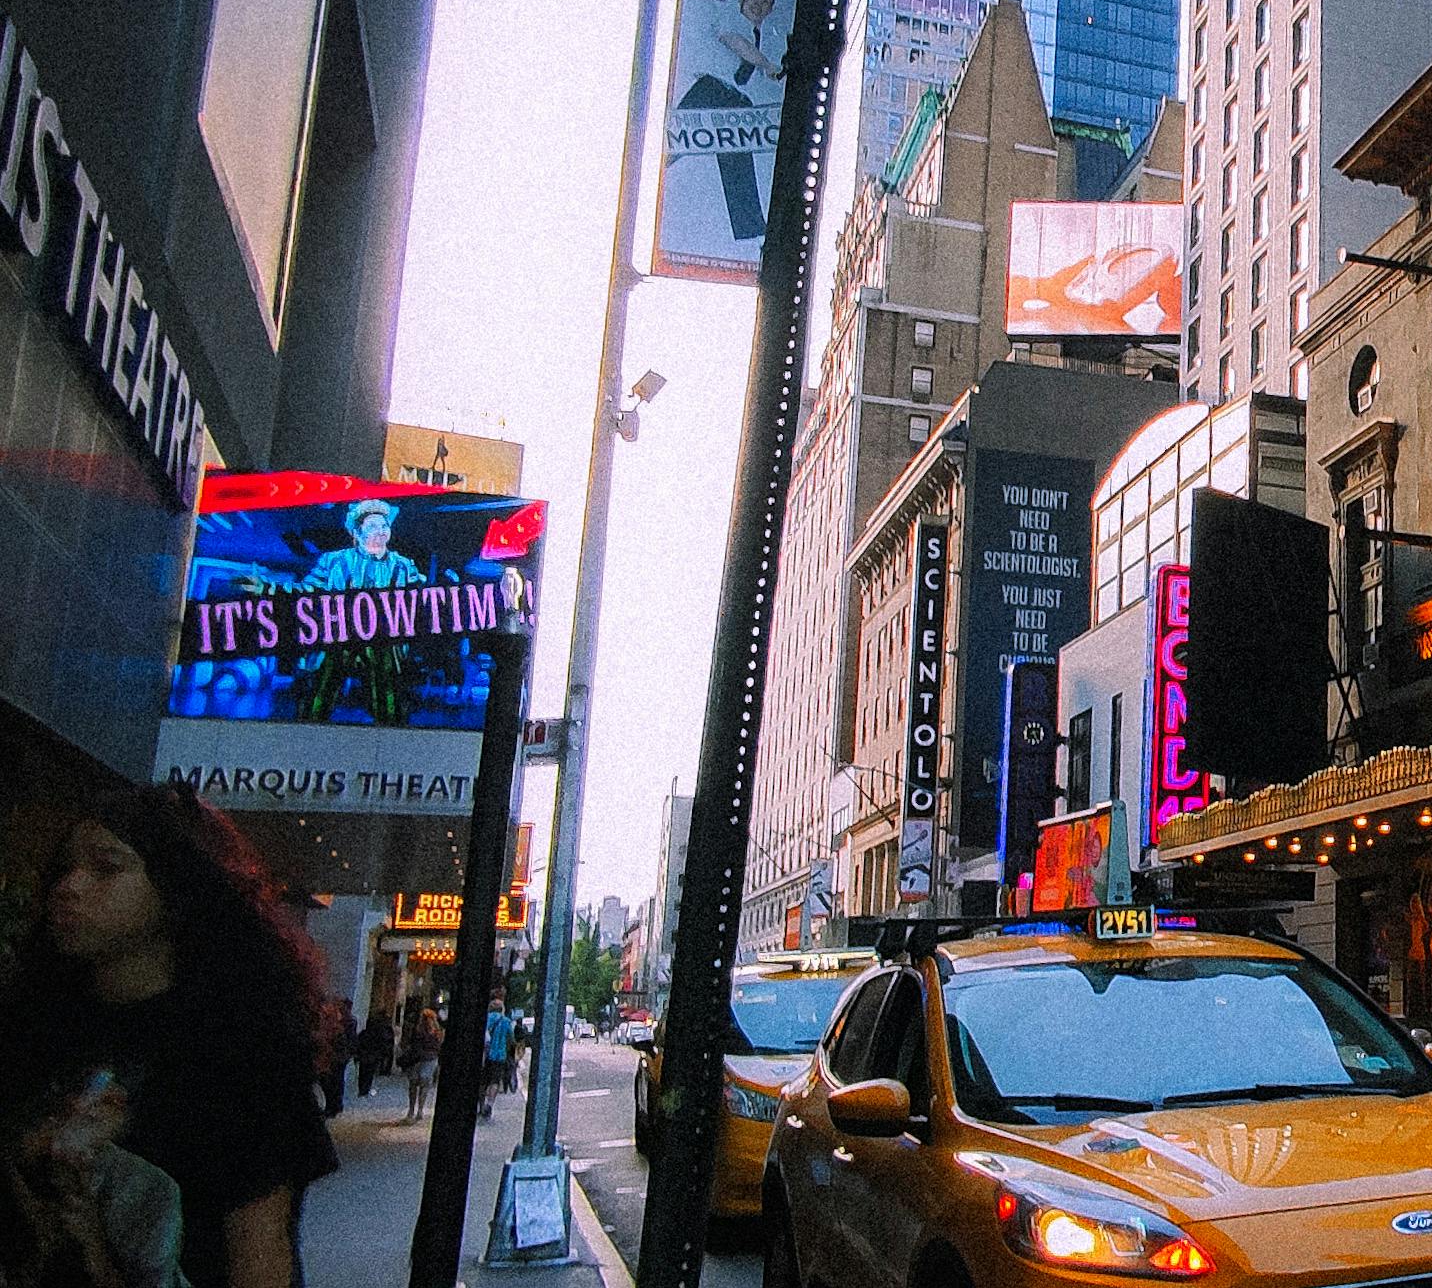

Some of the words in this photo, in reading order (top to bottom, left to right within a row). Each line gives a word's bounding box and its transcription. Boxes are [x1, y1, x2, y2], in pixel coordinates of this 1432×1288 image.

[66, 160, 206, 513] THEATRE
[1002, 484, 1029, 506] YOU
[1031, 488, 1070, 511] DON'T
[1019, 509, 1050, 530] NEED
[1010, 530, 1027, 550] TO
[1030, 533, 1046, 553] BE
[1049, 535, 1058, 553] A
[983, 551, 1081, 579] SCIENTOLOGIST.
[1002, 584, 1029, 606] YOU
[1031, 587, 1063, 610] JUST
[199, 601, 279, 654] IT'S
[297, 579, 535, 646] SHOWTIM!
[1015, 608, 1047, 630] NEED
[1012, 631, 1029, 652] TO
[1032, 633, 1049, 653] BE
[168, 766, 346, 801] MARQUIS
[415, 908, 510, 923] RODS
[1102, 910, 1147, 934] 2Y51
